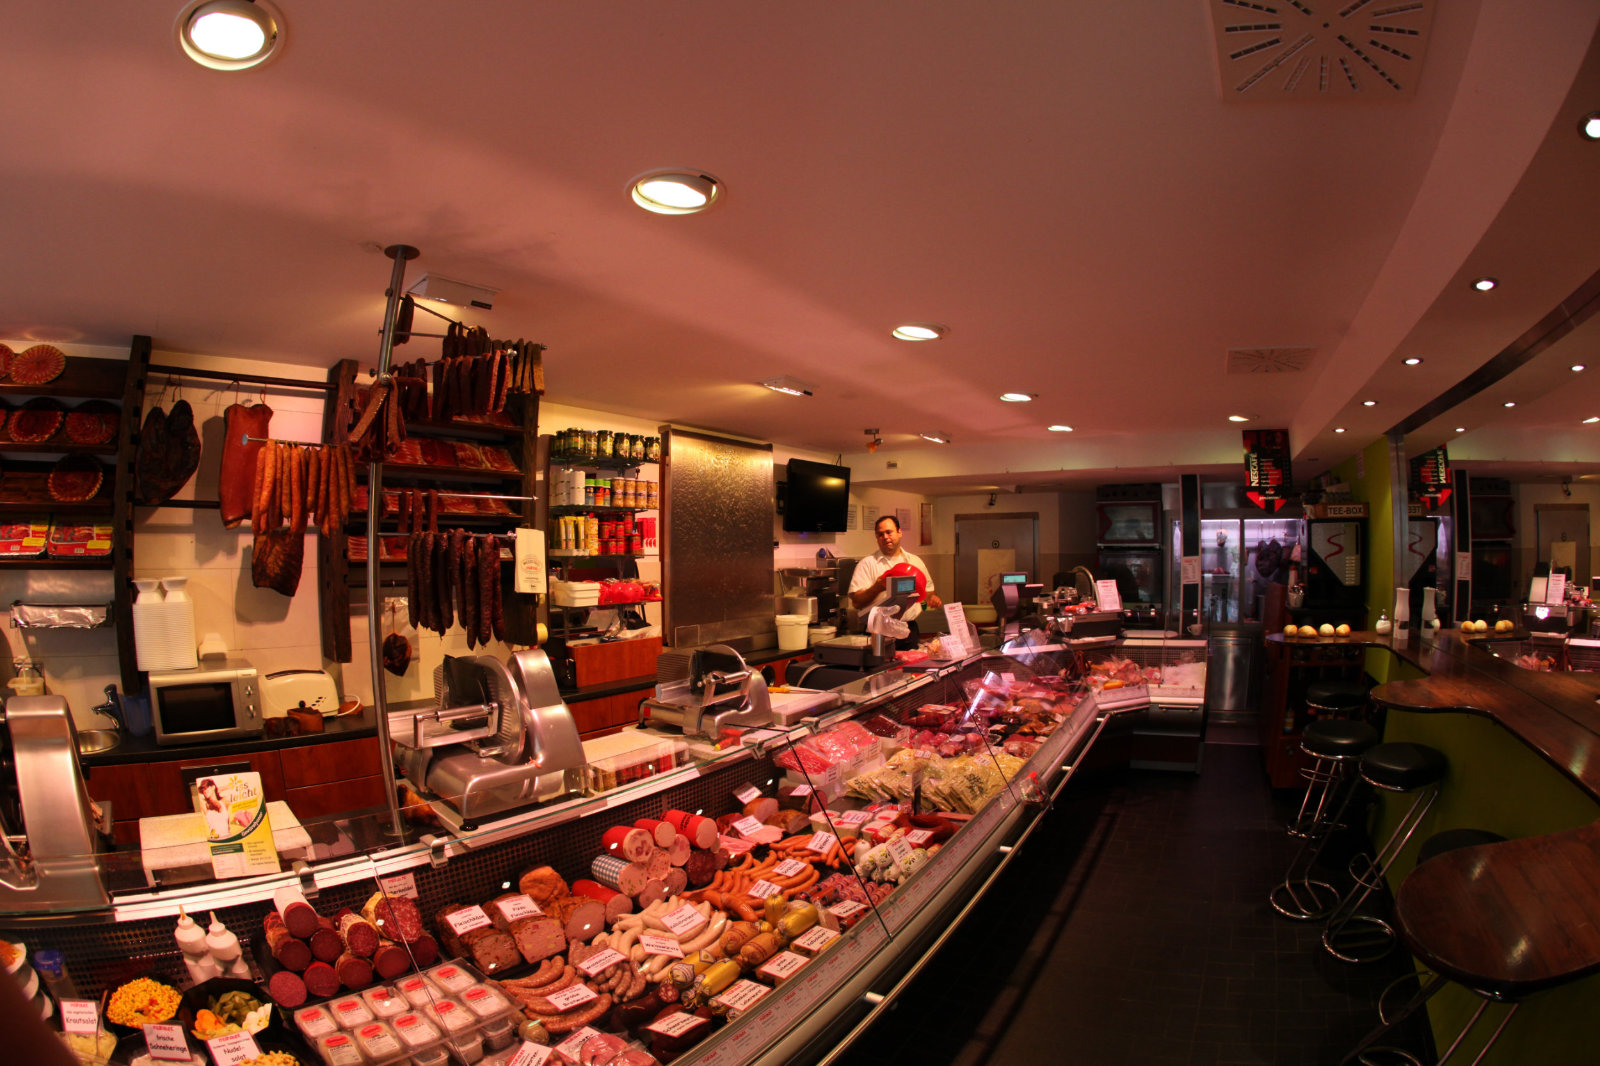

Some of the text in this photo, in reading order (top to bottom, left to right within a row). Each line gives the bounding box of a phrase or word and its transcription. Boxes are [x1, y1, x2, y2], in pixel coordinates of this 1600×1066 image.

[1327, 506, 1363, 515] TEE-BOX
[454, 914, 485, 928] Fleischkäse
[65, 1017, 97, 1025] Krautsalat
[223, 1045, 245, 1055] Nudel-
